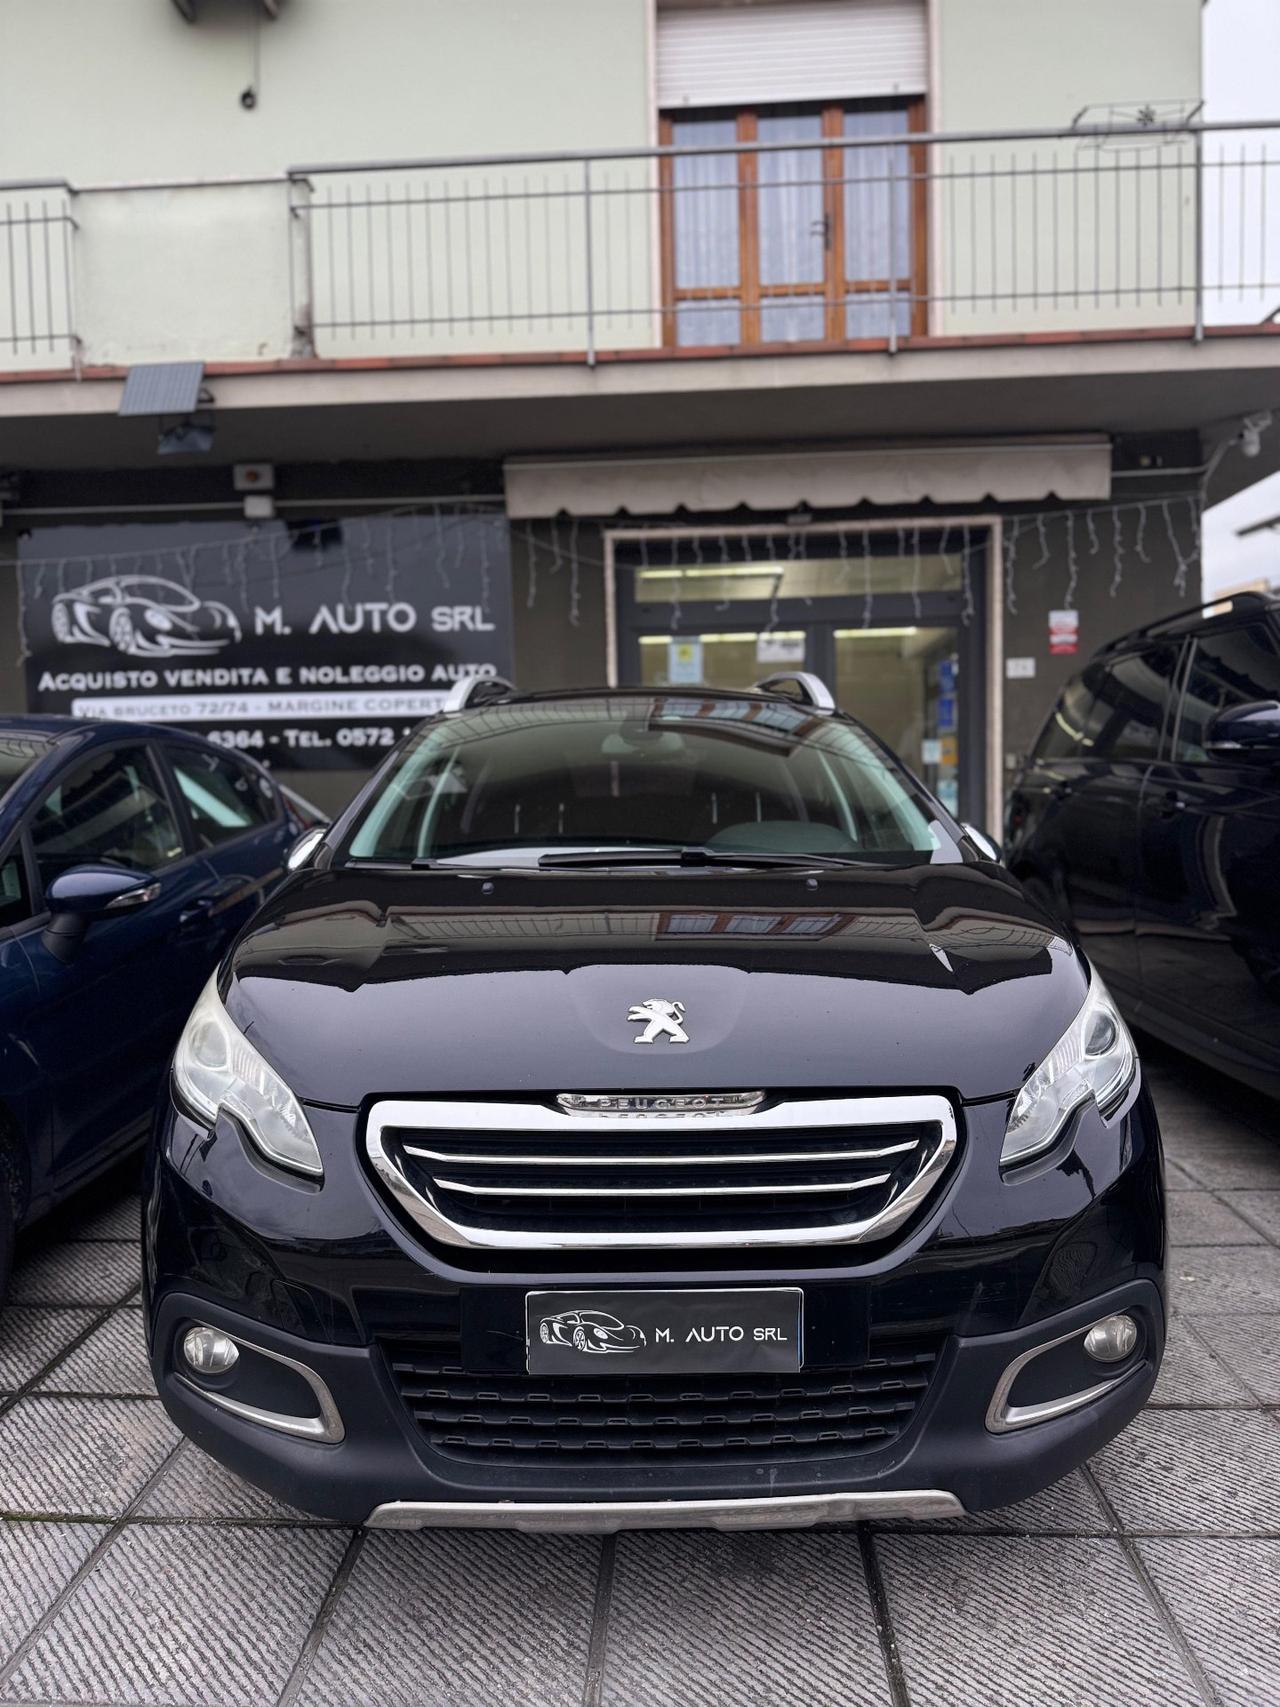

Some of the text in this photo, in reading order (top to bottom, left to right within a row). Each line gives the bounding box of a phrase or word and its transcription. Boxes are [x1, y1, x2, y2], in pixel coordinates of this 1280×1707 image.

[254, 602, 495, 635] M. AUTO SRL
[38, 662, 497, 692] ACQUISTO VENDITA E NOLEGGIO AUTO
[199, 701, 248, 714] 72/74
[268, 698, 358, 713] MARGINE
[364, 697, 446, 712] COPERT
[283, 728, 332, 747] TEL.
[336, 727, 395, 747] 0572
[600, 1097, 724, 1110] PEUGEOT
[655, 1325, 788, 1343] M. AUTO SRL
